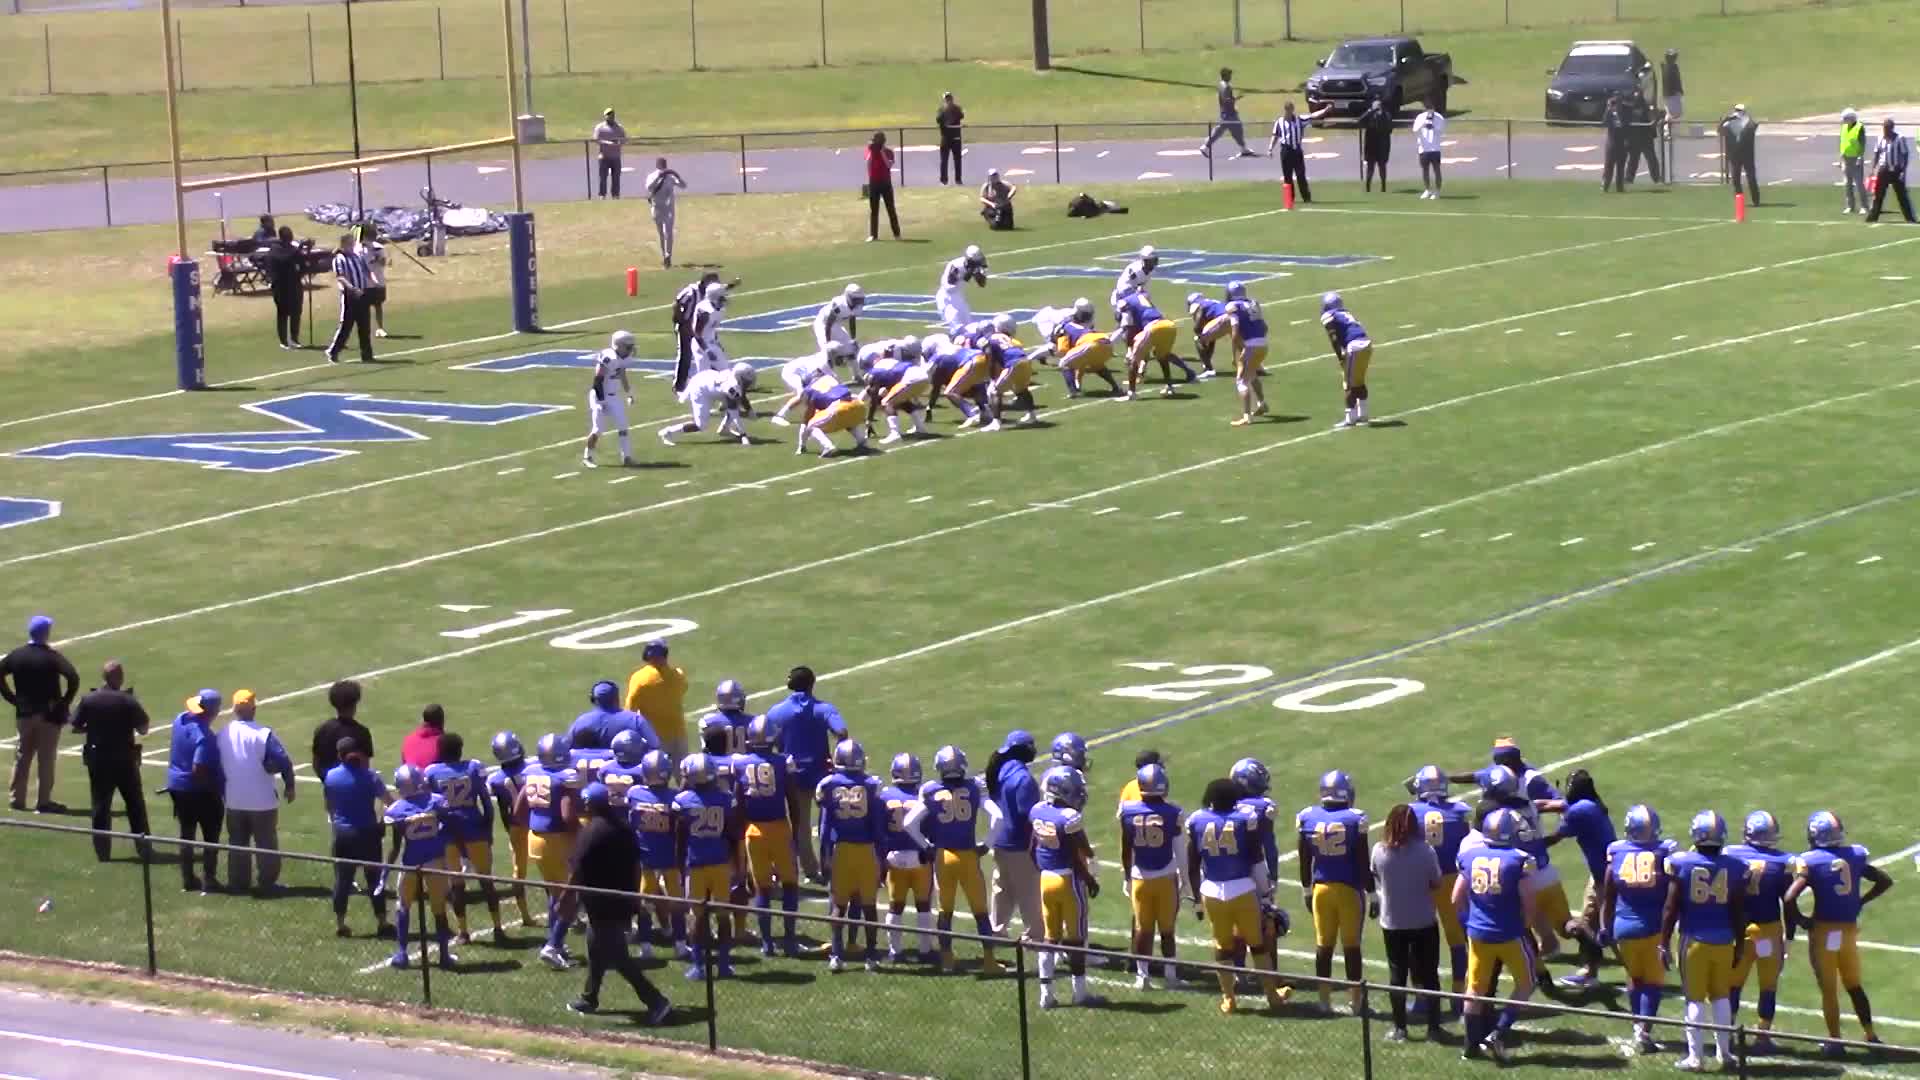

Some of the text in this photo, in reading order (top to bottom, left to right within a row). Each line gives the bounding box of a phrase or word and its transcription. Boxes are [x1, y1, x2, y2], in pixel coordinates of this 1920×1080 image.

[1102, 664, 1425, 713] 20
[745, 762, 776, 797] 19
[690, 805, 725, 837] 29
[934, 789, 972, 824] 36
[1132, 814, 1165, 848] 16
[1202, 820, 1238, 856] 44
[1311, 821, 1347, 856] 42
[1617, 851, 1657, 888] 48
[1690, 866, 1729, 904] 64
[1831, 858, 1852, 896] 3
